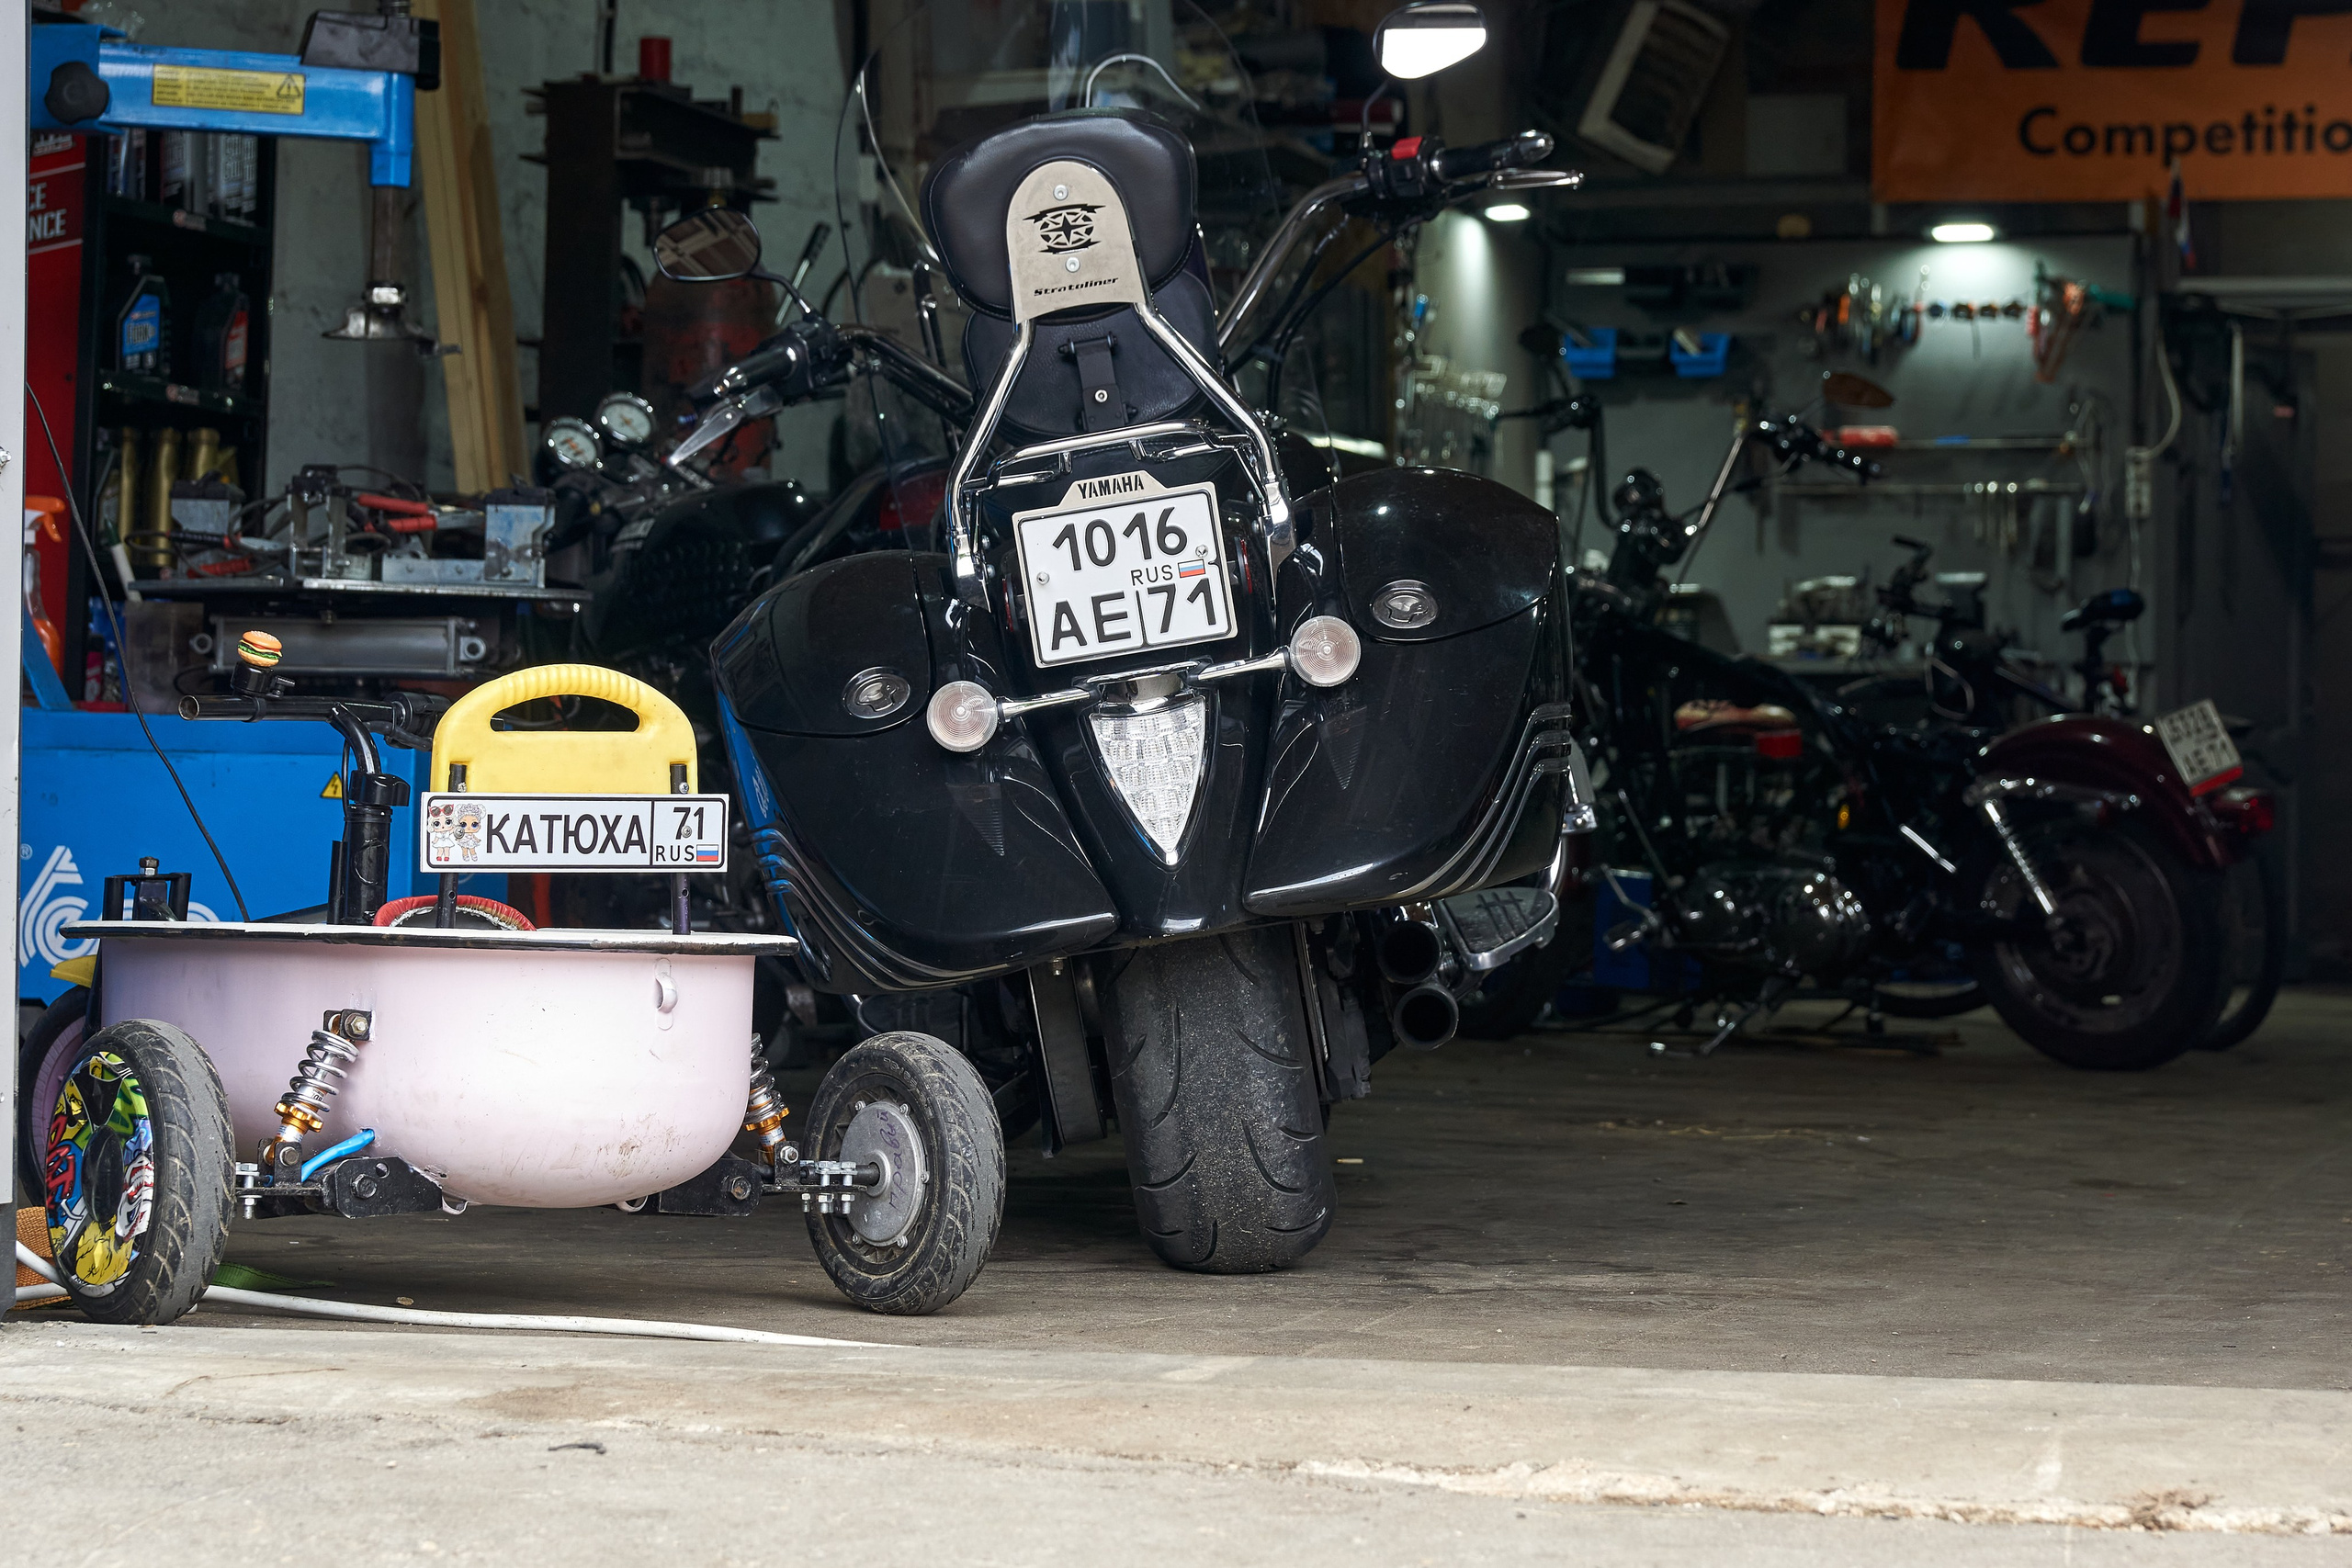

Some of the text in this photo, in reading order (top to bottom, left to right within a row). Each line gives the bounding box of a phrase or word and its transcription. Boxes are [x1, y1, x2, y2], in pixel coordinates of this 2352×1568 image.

[2018, 104, 2352, 168] Competitio
[1034, 277, 1119, 297] Stratoliner
[1077, 474, 1145, 500] YAMAHA
[1052, 506, 1188, 571] 1016
[1130, 564, 1174, 587] RUS
[1147, 578, 1216, 634] 71
[486, 813, 648, 854] КАТЮХА
[673, 807, 706, 840] 71
[655, 843, 695, 862] RUS
